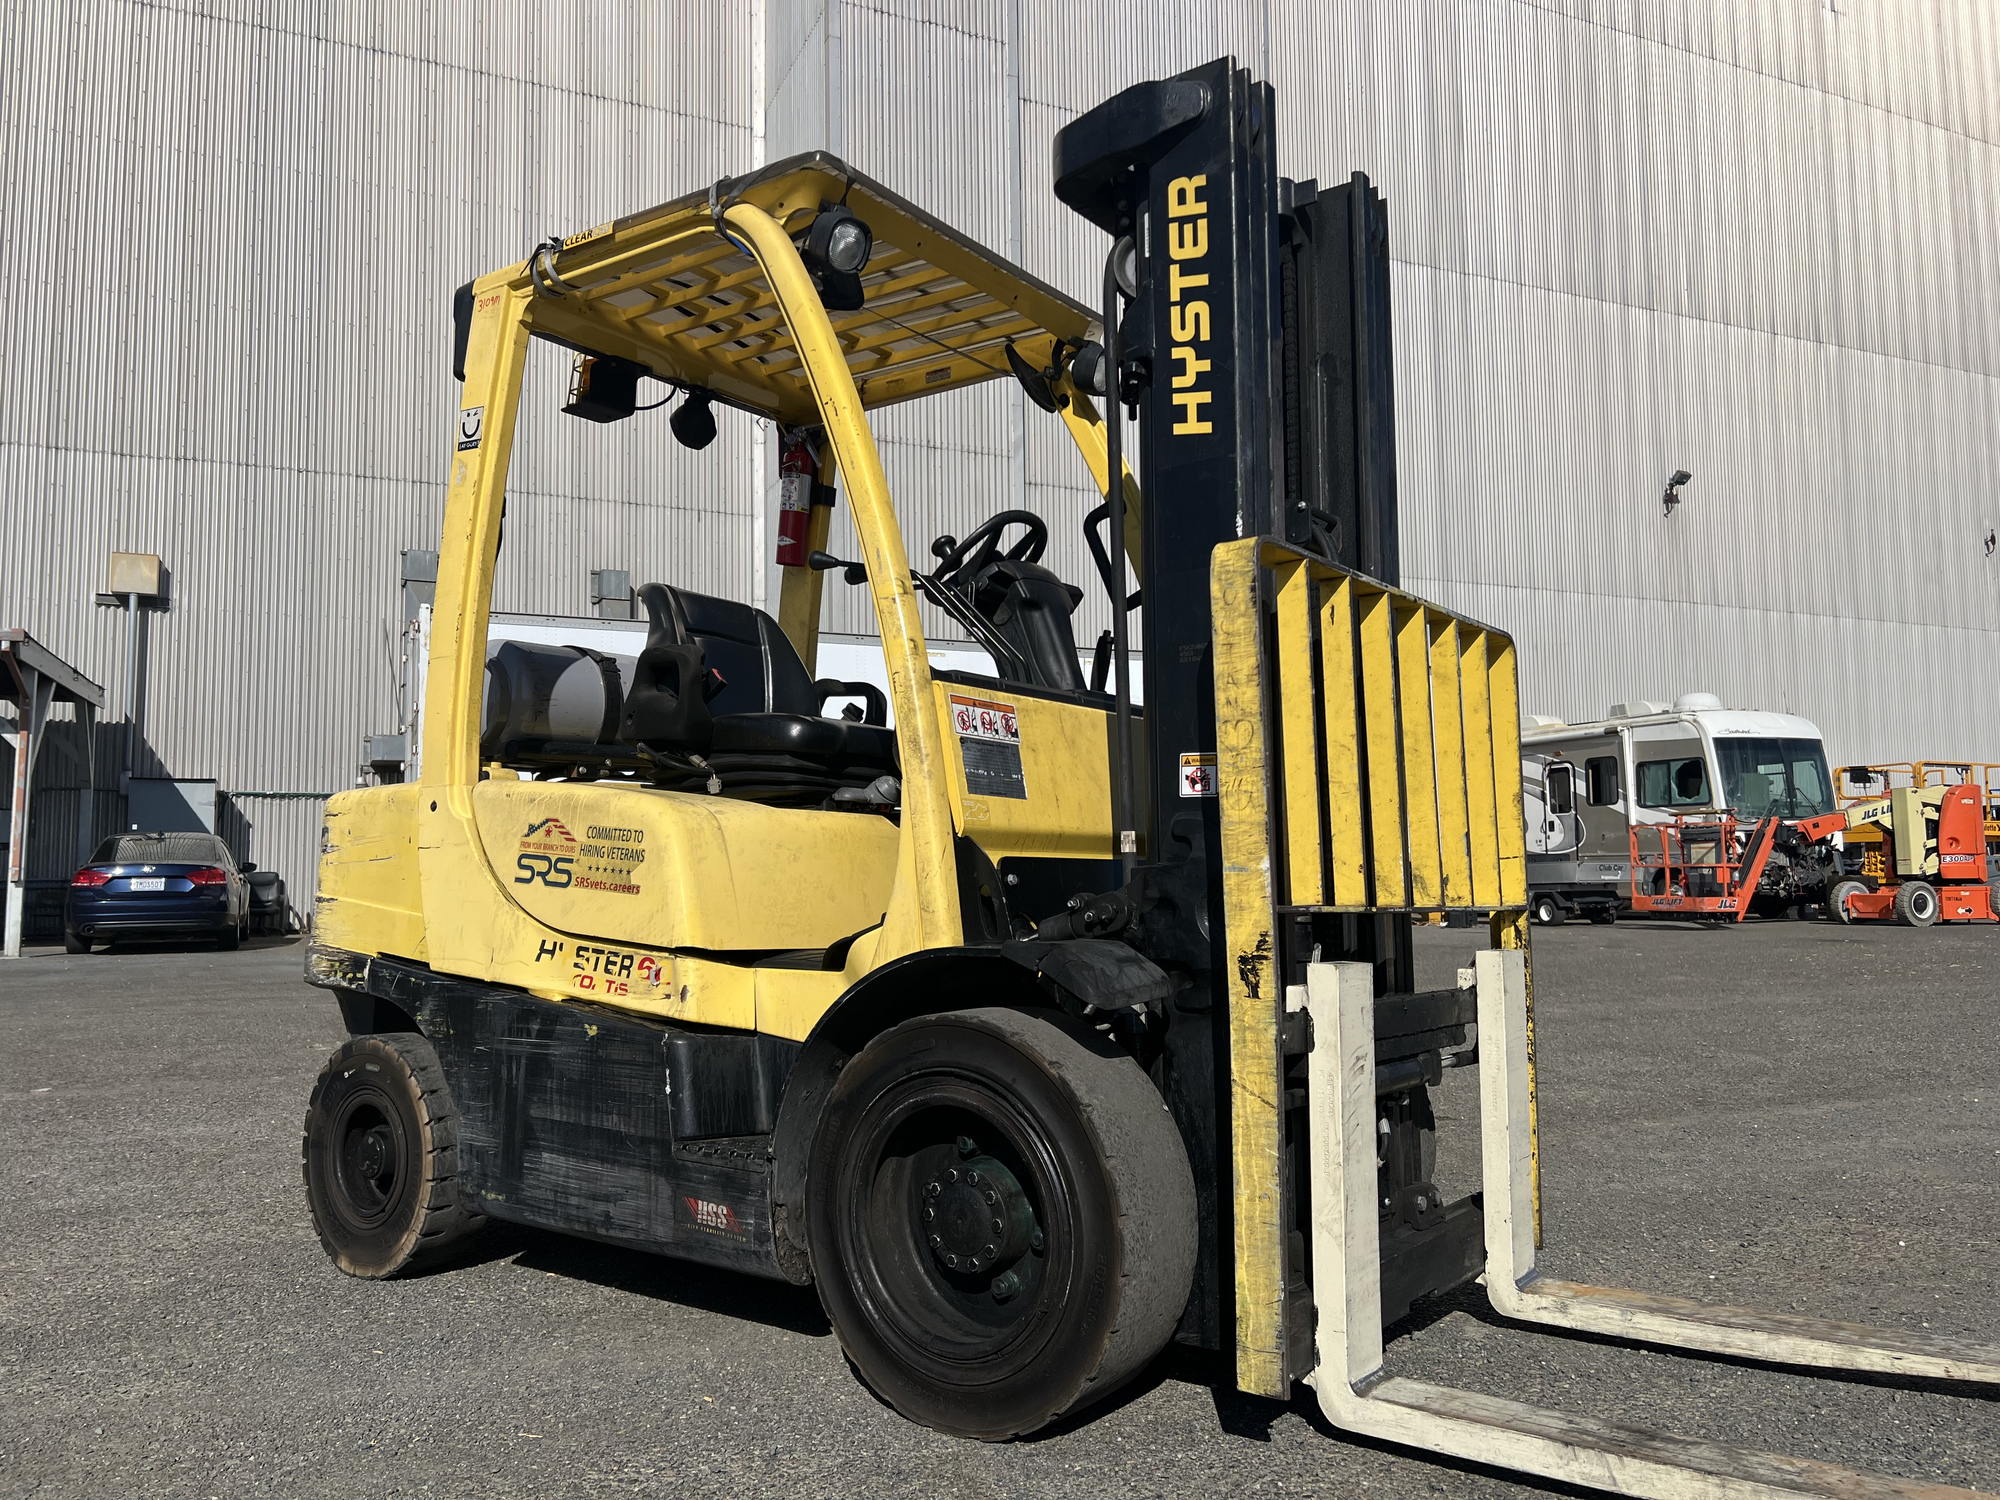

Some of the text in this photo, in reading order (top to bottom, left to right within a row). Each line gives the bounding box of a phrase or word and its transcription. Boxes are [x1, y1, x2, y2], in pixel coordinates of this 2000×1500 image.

[1168, 174, 1212, 435] HYSTER
[1862, 807, 1878, 820] JLG
[586, 826, 644, 843] COMMITTED TO
[579, 844, 645, 862] HIRING VETERANS
[514, 853, 574, 888] SRS
[574, 876, 641, 894] SRSvets.careers
[1718, 899, 1737, 908] JLG
[534, 939, 634, 979] HSTER
[697, 1200, 728, 1229] HSS
